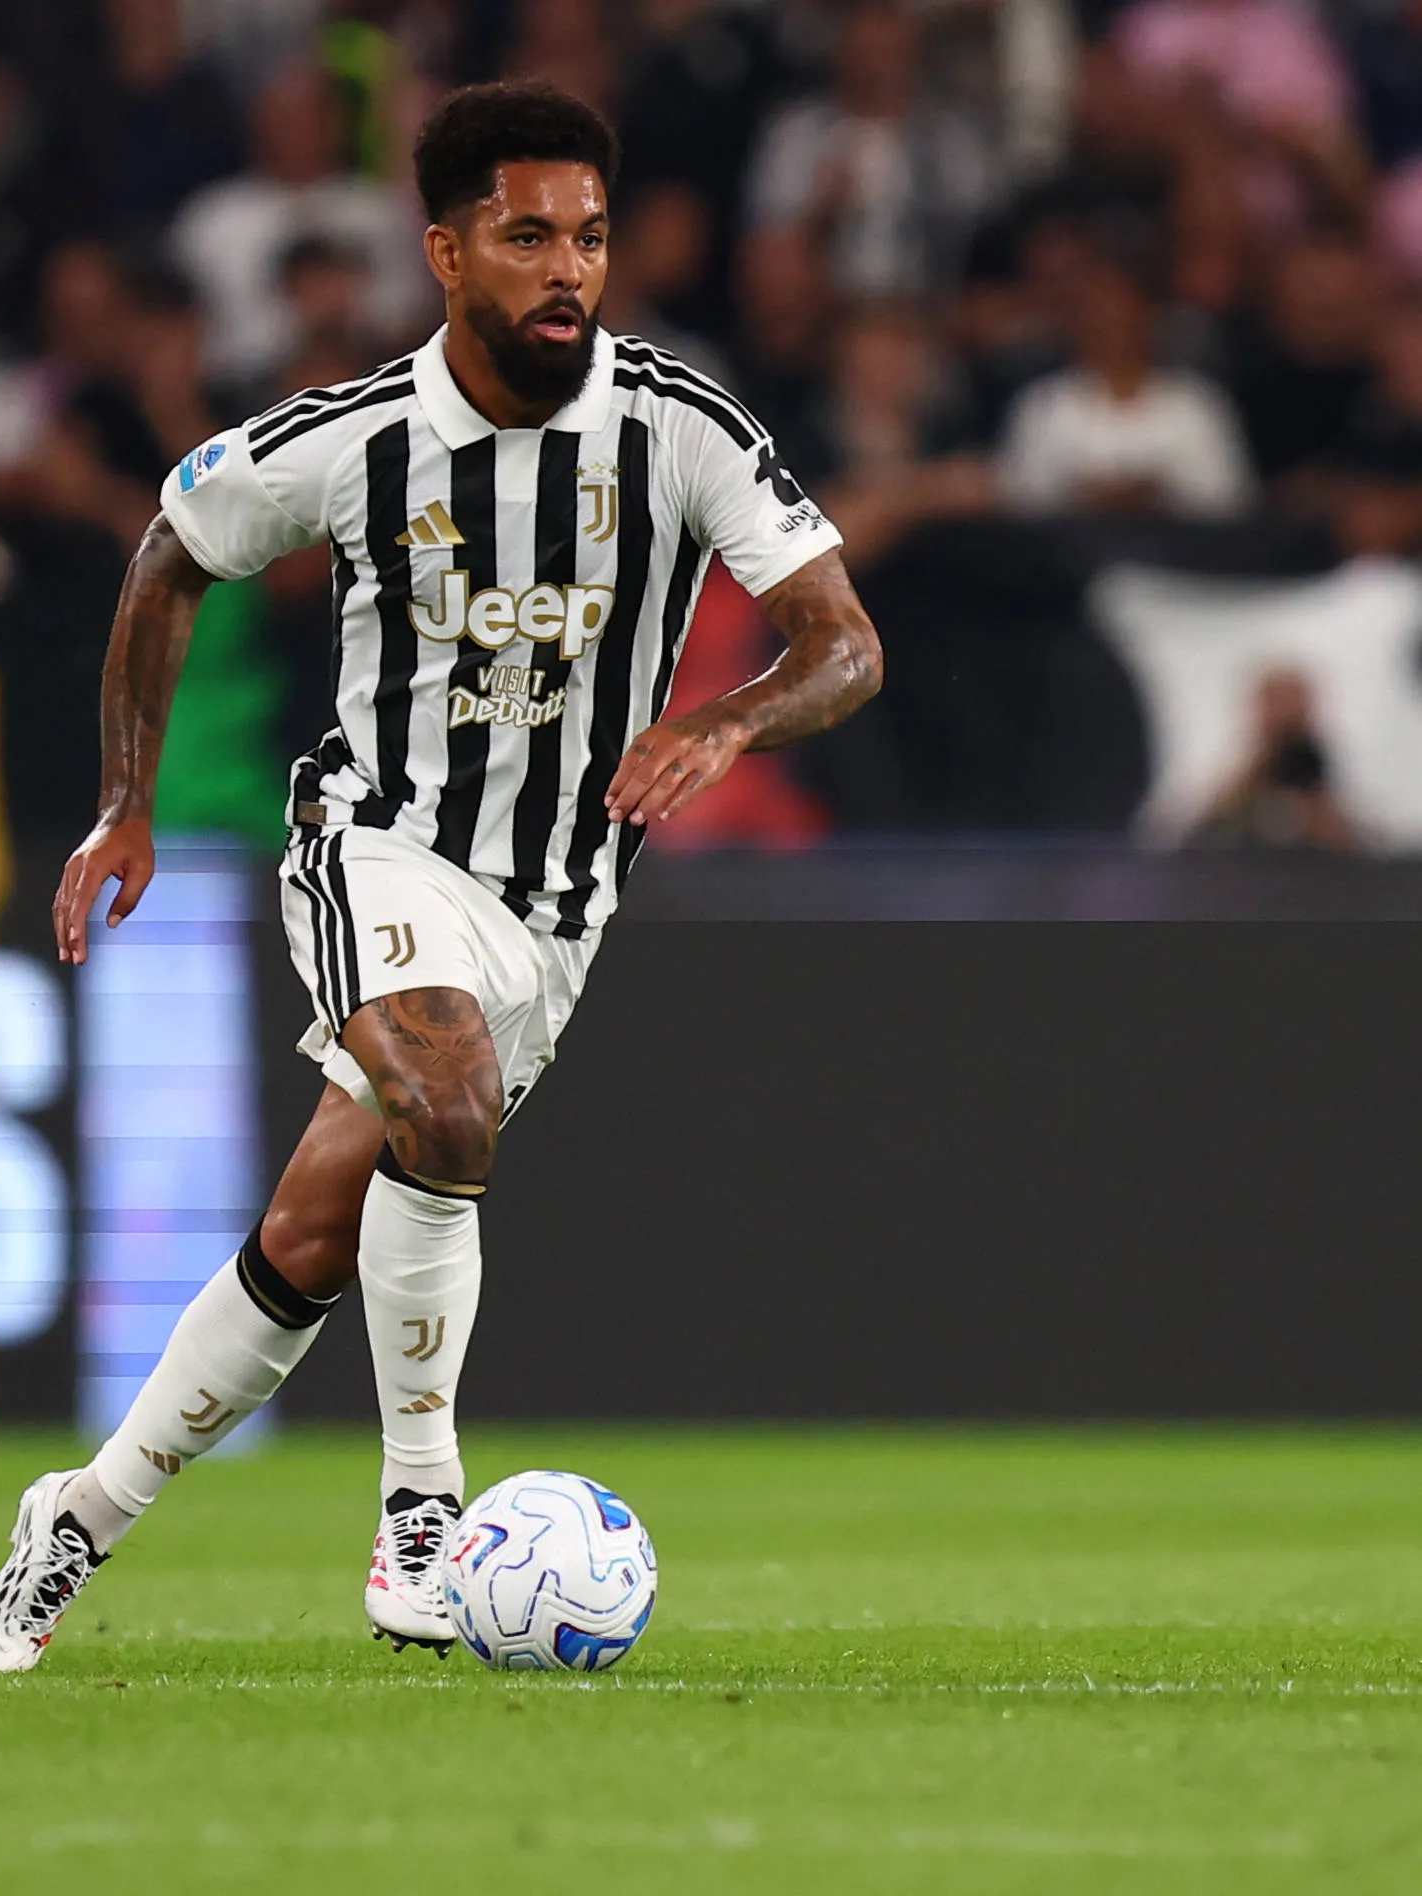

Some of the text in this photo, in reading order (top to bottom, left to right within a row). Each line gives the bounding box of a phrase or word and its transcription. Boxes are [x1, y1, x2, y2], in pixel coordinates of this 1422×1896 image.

[407, 569, 616, 661] Jeep
[478, 665, 546, 697] VISIT
[447, 685, 567, 730] Detroit
